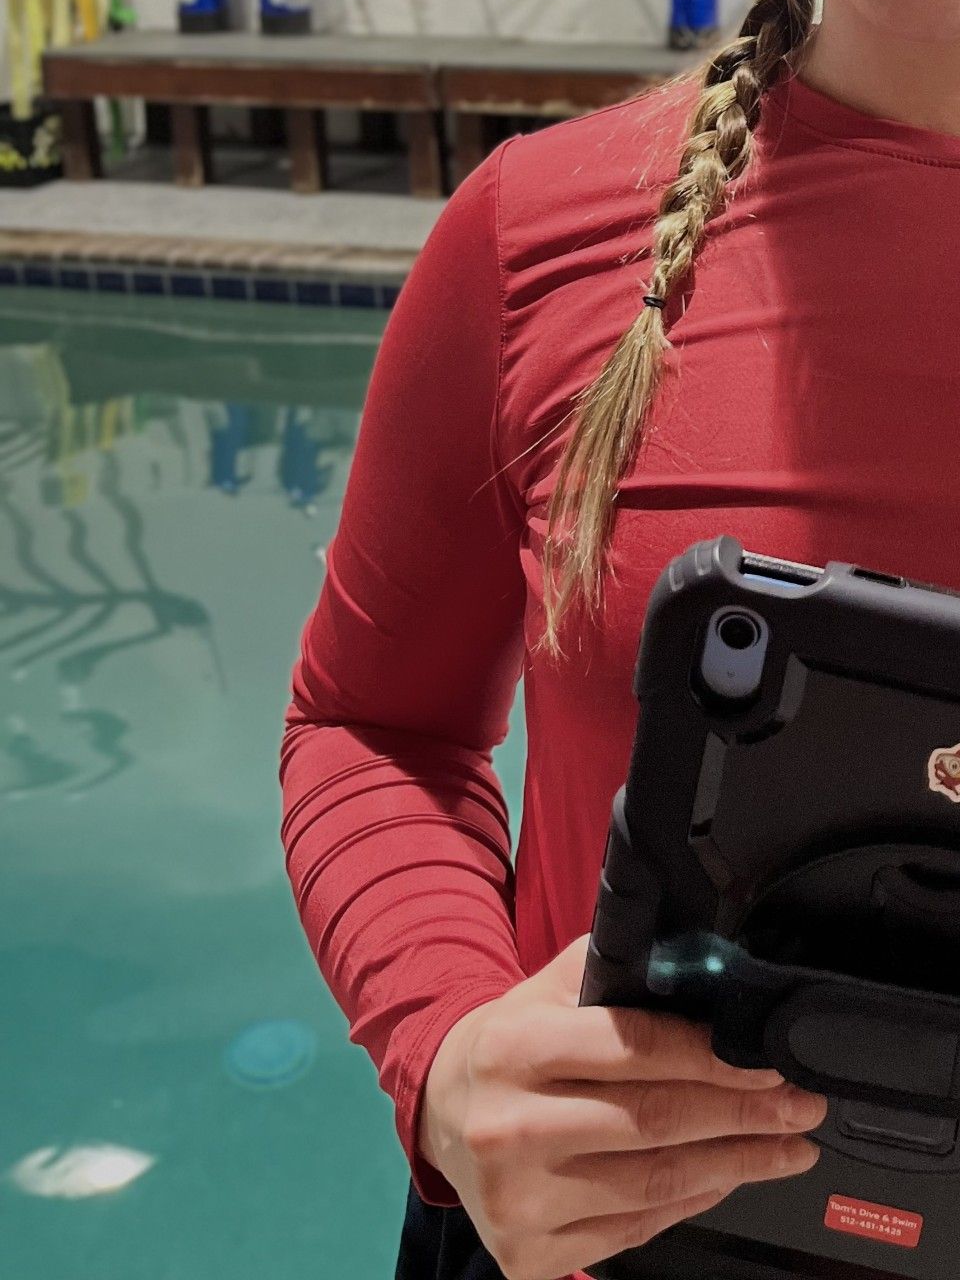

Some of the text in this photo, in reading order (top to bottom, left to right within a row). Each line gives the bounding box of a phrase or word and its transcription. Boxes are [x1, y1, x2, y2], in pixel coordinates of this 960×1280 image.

[830, 1201, 857, 1215] Tom's
[859, 1207, 880, 1220] Dive
[892, 1215, 917, 1229] Swim
